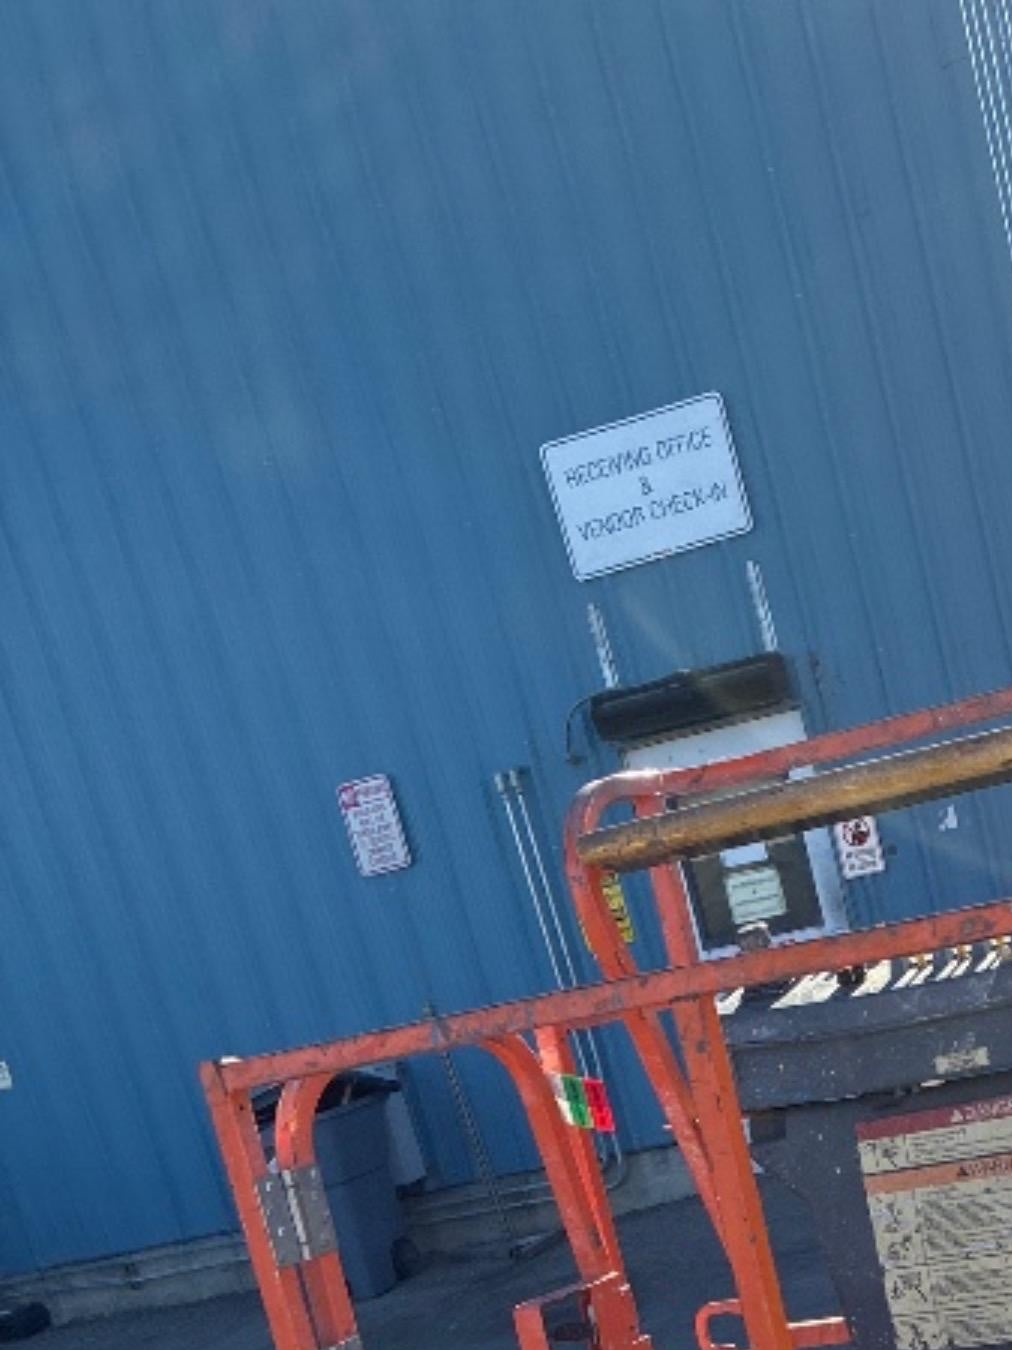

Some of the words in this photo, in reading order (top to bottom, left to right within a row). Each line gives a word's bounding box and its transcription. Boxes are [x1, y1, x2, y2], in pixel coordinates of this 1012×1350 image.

[656, 426, 712, 459] OFFICE
[639, 477, 654, 496] &
[578, 506, 646, 541] VENDOR
[650, 482, 728, 519] CHECK-IN
